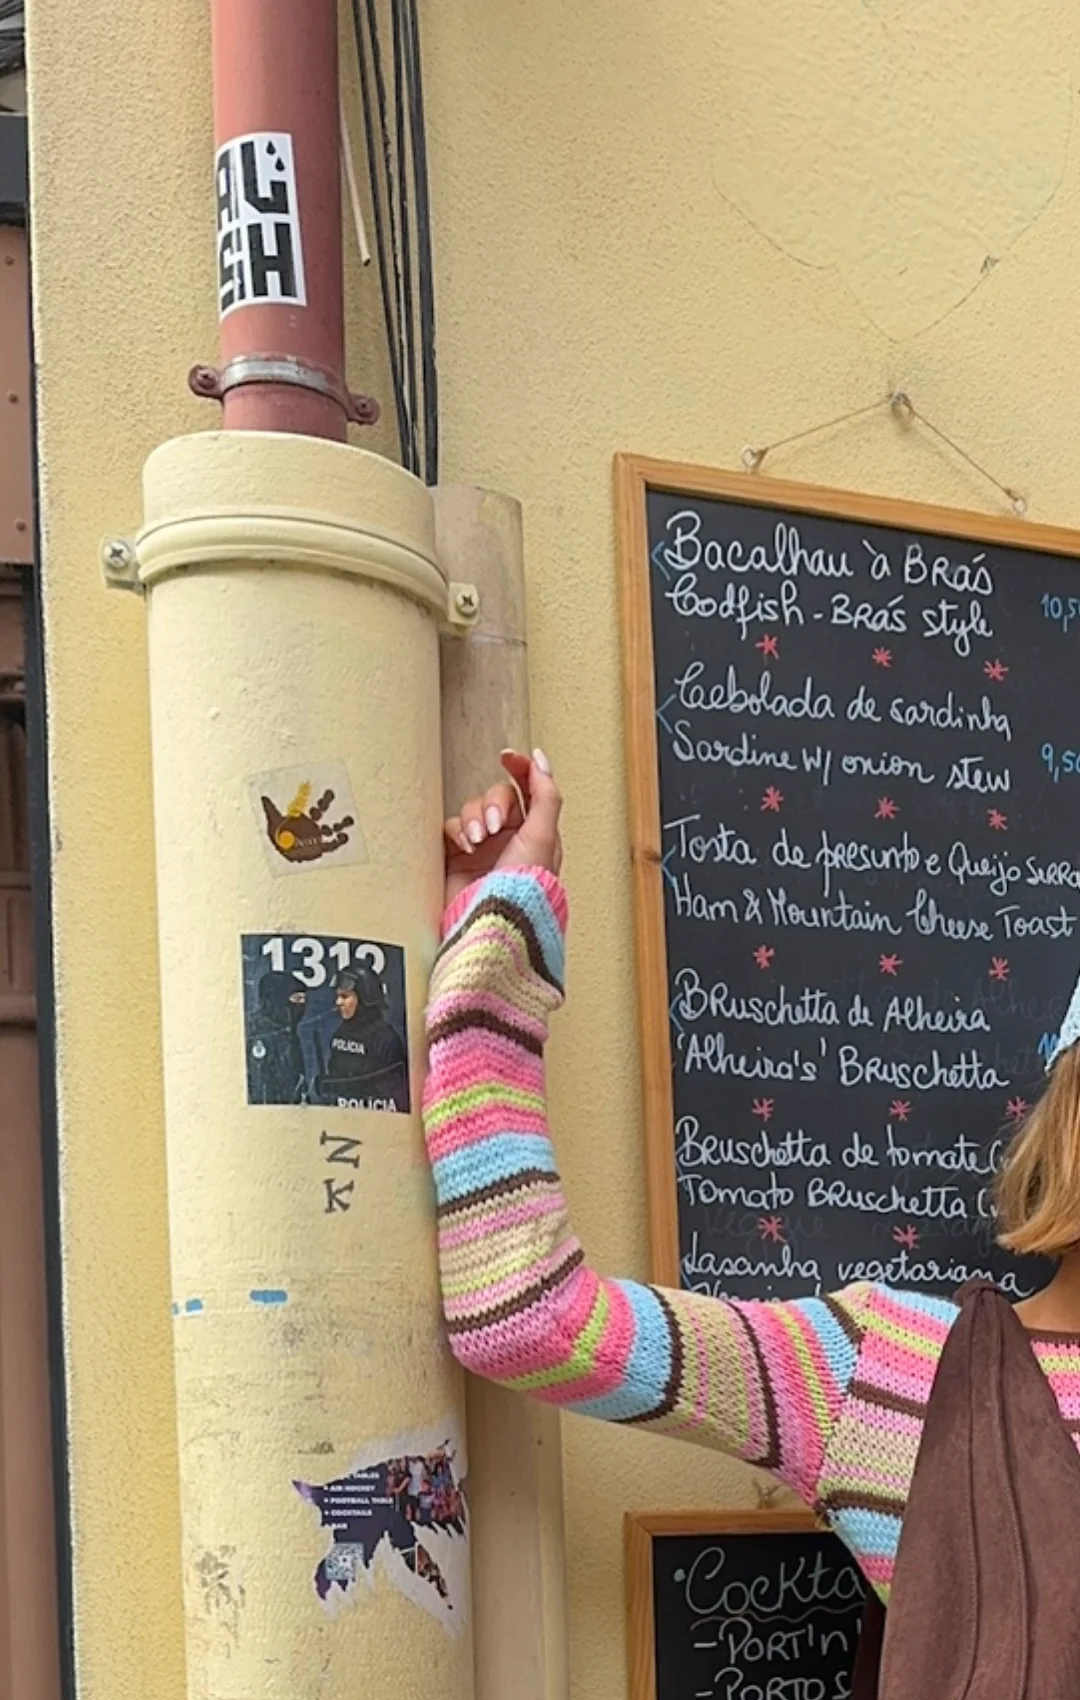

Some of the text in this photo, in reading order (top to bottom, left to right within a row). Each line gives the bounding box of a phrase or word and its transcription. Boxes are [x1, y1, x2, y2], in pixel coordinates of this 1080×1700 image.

[664, 510, 854, 577] Bacalhau
[862, 539, 892, 580] à
[665, 572, 805, 640] Codfish
[922, 599, 993, 657] style
[674, 661, 836, 719] Cebolada
[847, 685, 882, 722] de
[672, 720, 798, 769] Sardine
[842, 752, 935, 784] onion
[946, 756, 1011, 793] stew
[663, 814, 757, 865] Tosta
[772, 828, 812, 868] de
[925, 853, 942, 875] e
[948, 841, 1021, 897] Queijo
[672, 872, 1078, 941] Ham & Mountain Cheese Toast
[847, 994, 875, 1028] de
[882, 995, 992, 1033] Alheira
[842, 1131, 880, 1169] de
[676, 1171, 794, 1210] Tomato
[684, 1231, 821, 1281] Lasanha
